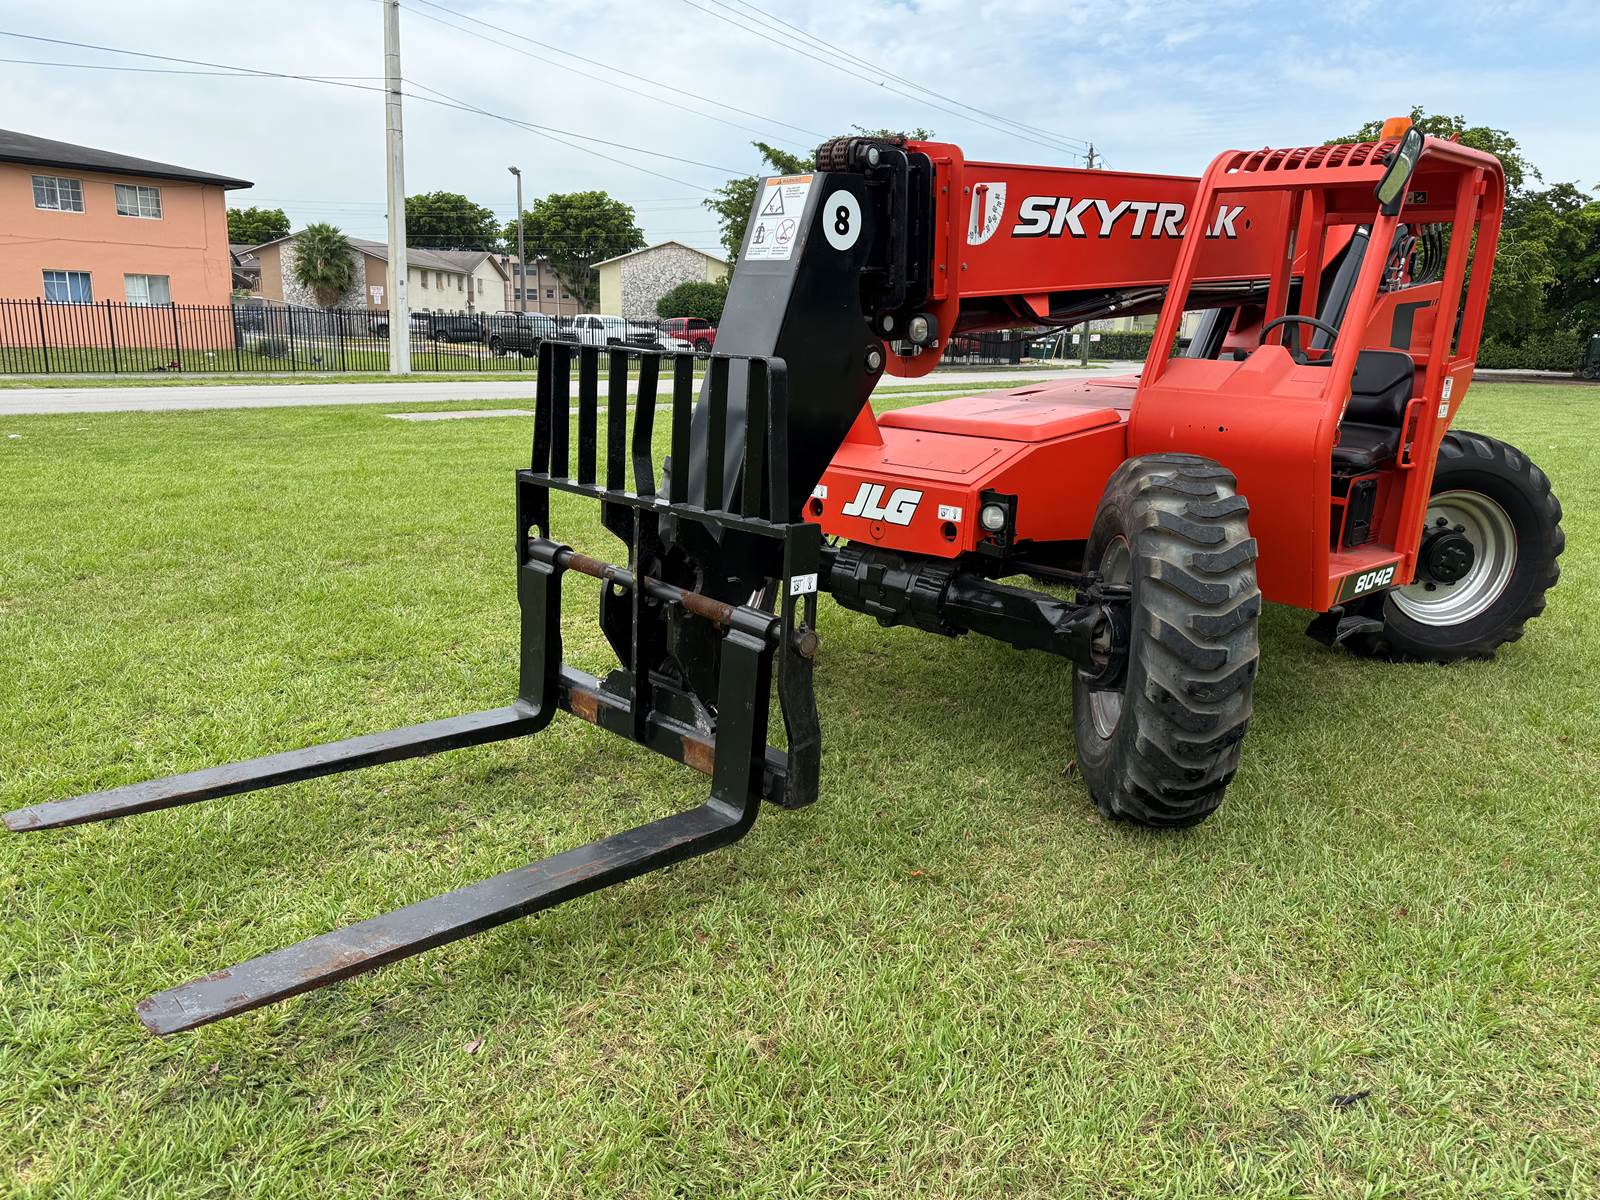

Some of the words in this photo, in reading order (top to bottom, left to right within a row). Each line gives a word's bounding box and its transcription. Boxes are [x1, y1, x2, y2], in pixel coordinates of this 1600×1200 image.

[834, 205, 850, 236] 8
[1011, 196, 1246, 239] SKYTRK
[841, 482, 924, 526] JLG
[1354, 566, 1394, 594] 8042
